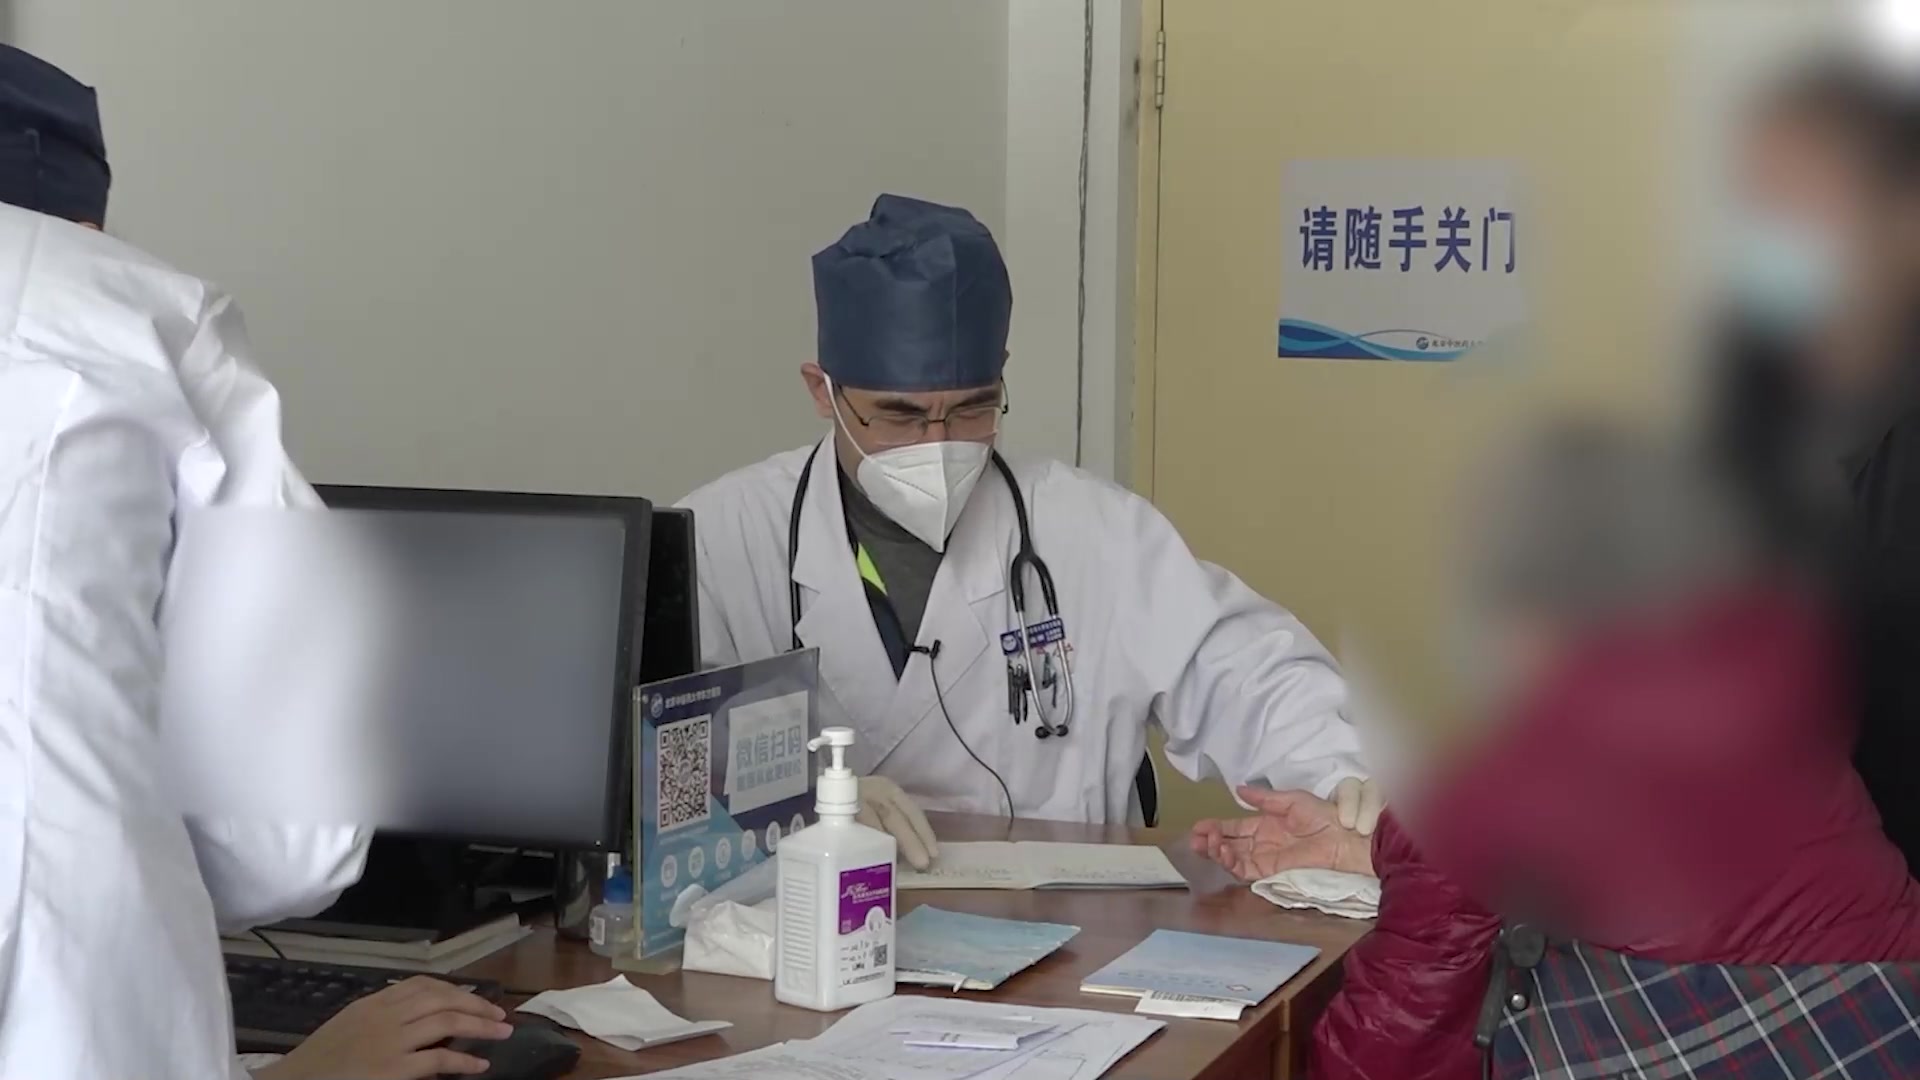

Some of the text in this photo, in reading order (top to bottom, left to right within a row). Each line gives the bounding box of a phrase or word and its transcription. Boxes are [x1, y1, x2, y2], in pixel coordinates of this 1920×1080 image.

[1299, 206, 1515, 273] 请随手关门
[736, 725, 801, 770] 微信扫码
